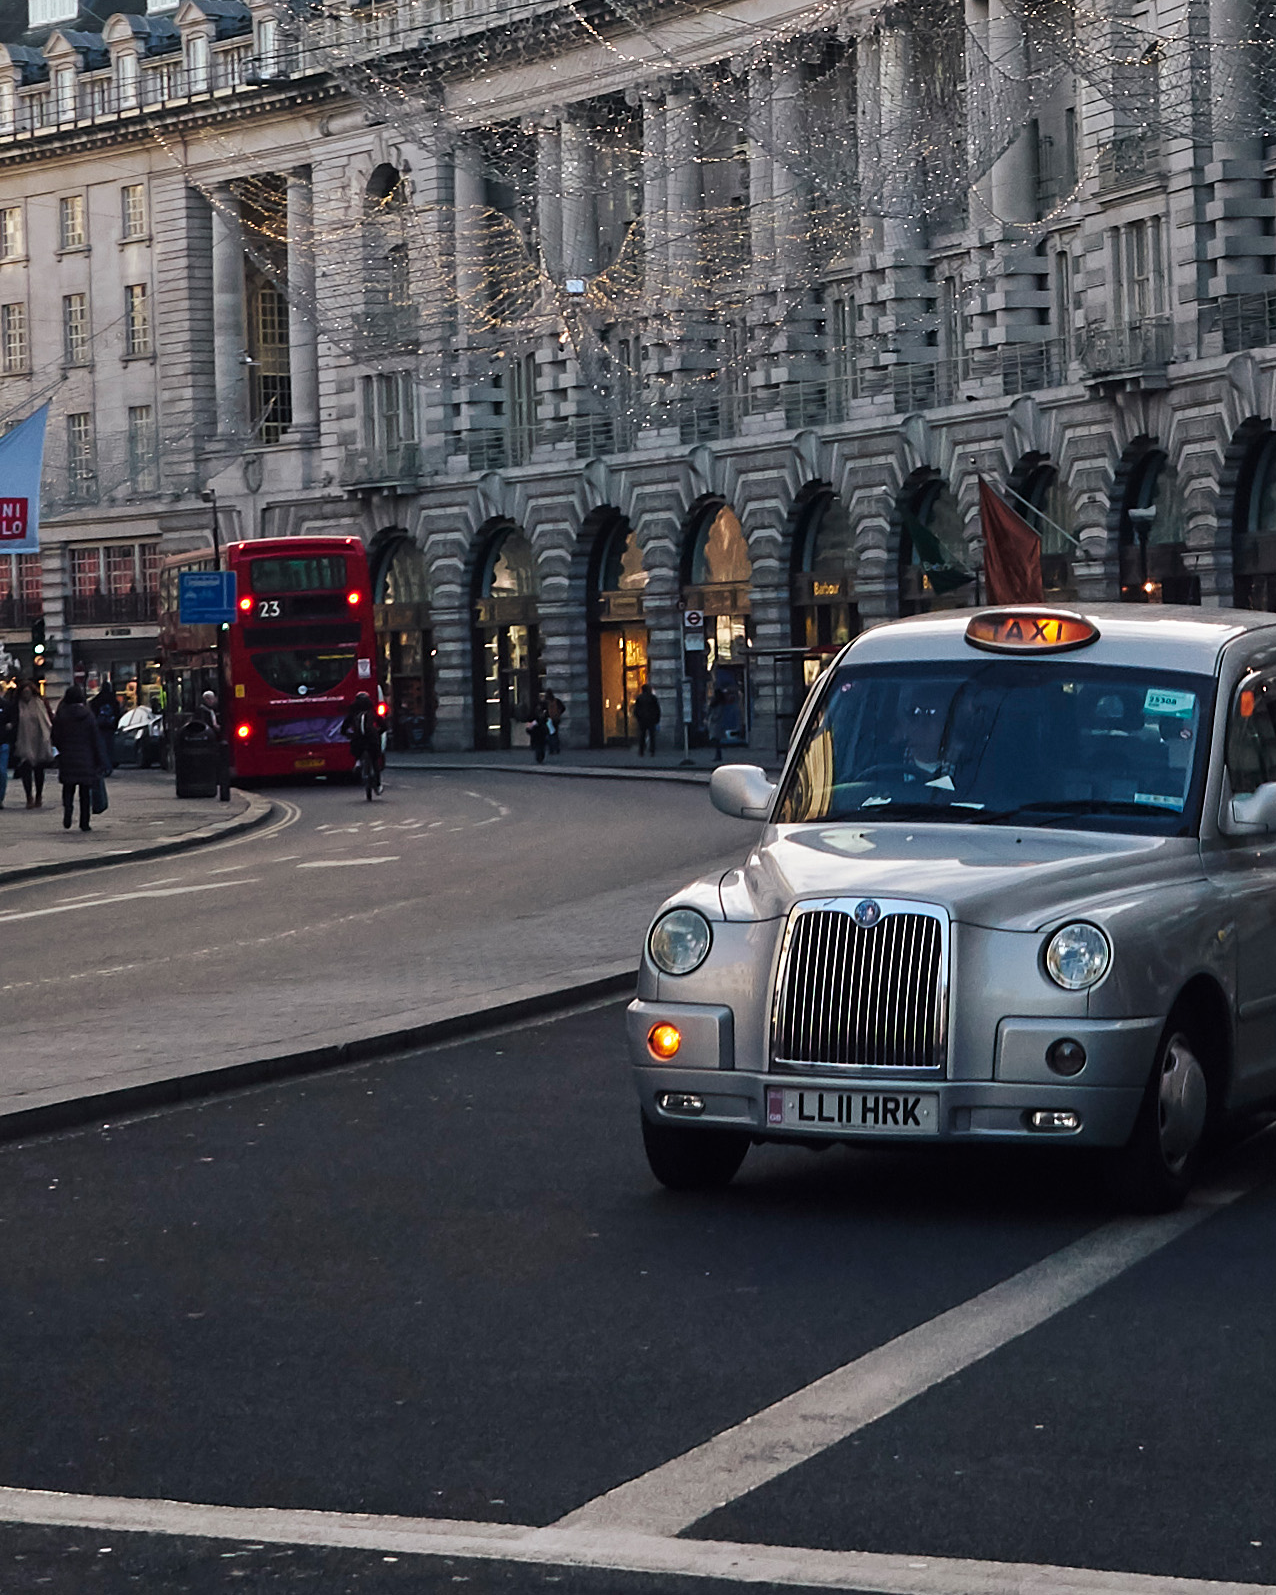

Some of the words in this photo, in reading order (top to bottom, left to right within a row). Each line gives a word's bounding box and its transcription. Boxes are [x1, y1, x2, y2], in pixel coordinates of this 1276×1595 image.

[813, 581, 841, 596] Barbour
[259, 600, 280, 617] 23
[986, 619, 1063, 642] TAXI
[861, 1095, 921, 1127] HRK
